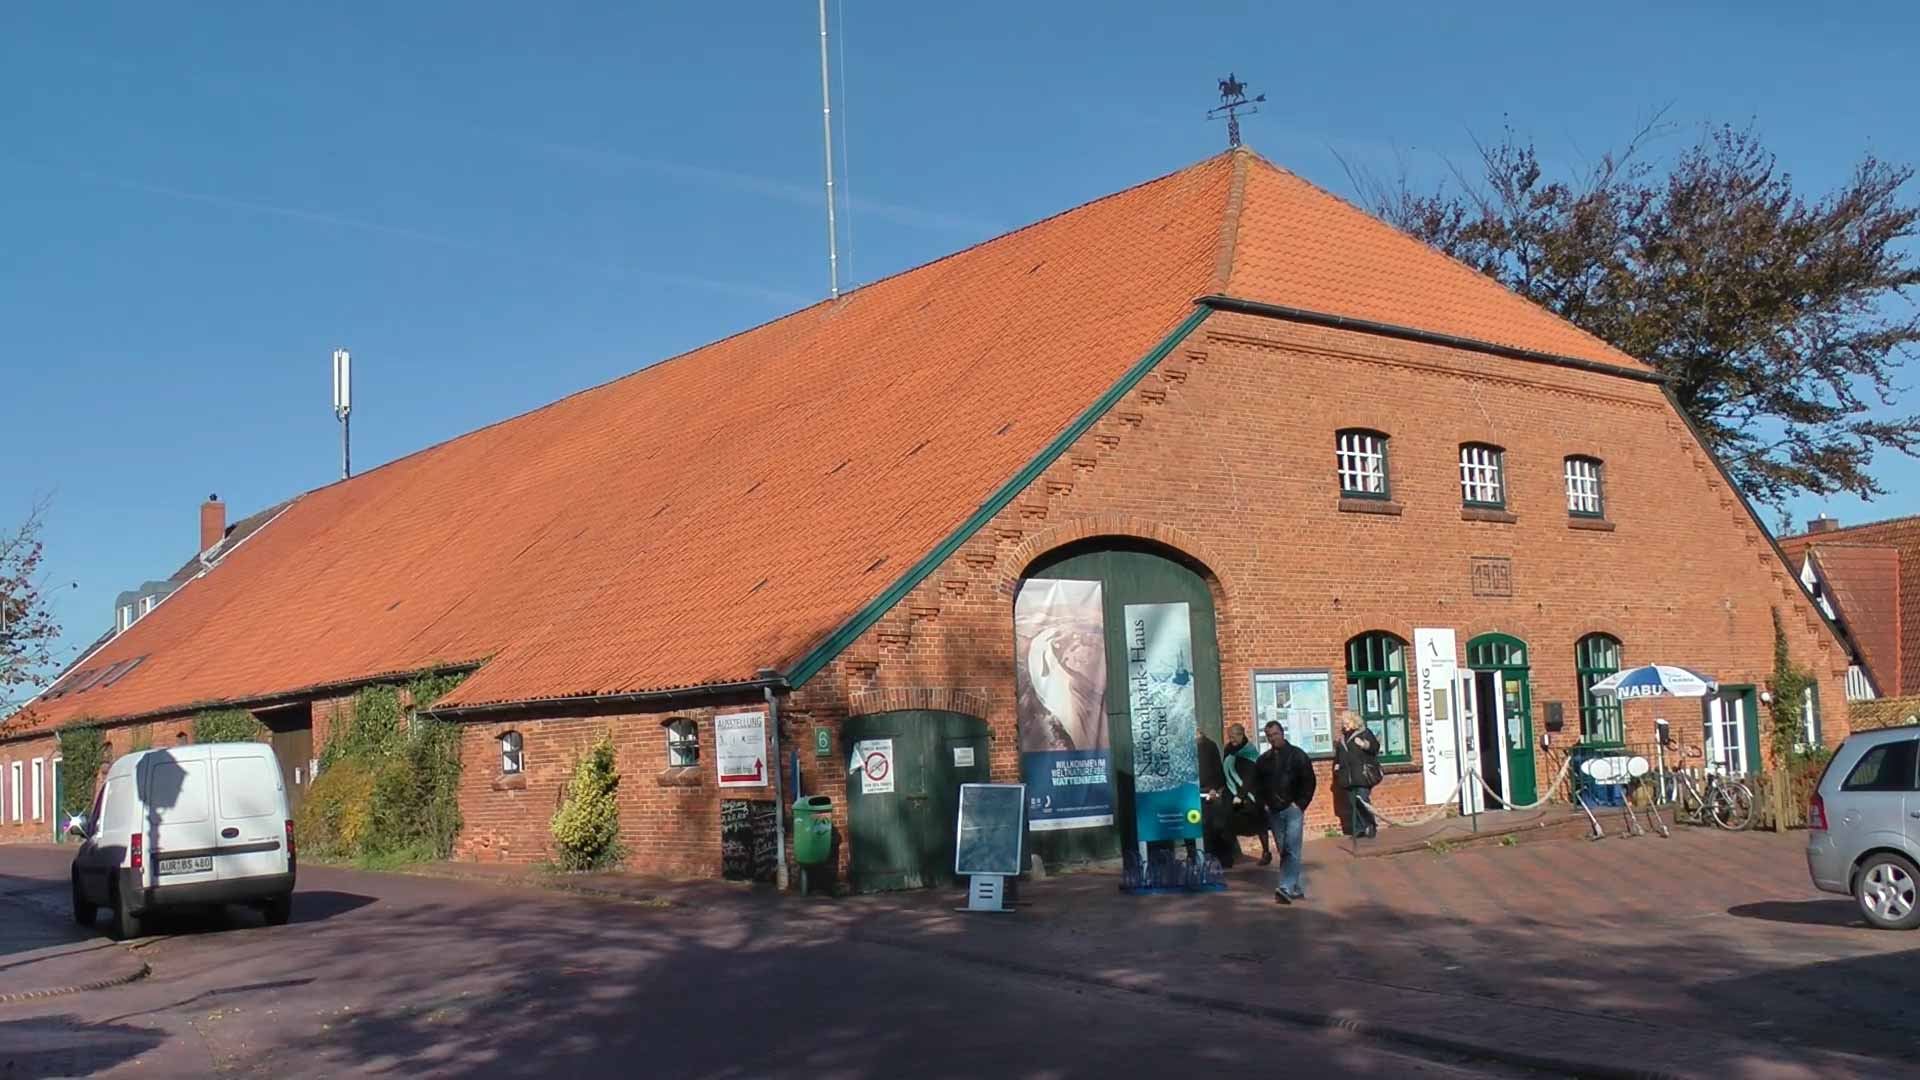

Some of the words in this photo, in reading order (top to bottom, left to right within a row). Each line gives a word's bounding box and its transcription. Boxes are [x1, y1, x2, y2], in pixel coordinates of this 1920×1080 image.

[1474, 564, 1509, 590] 1909
[1131, 618, 1154, 776] Nationalpark-Haus
[1618, 683, 1662, 698] NABU
[717, 716, 762, 730] AUSSTELLUNG
[1422, 668, 1438, 776] AUSSTELLUNG
[819, 731, 828, 748] 6
[1152, 706, 1171, 778] Greetsiel
